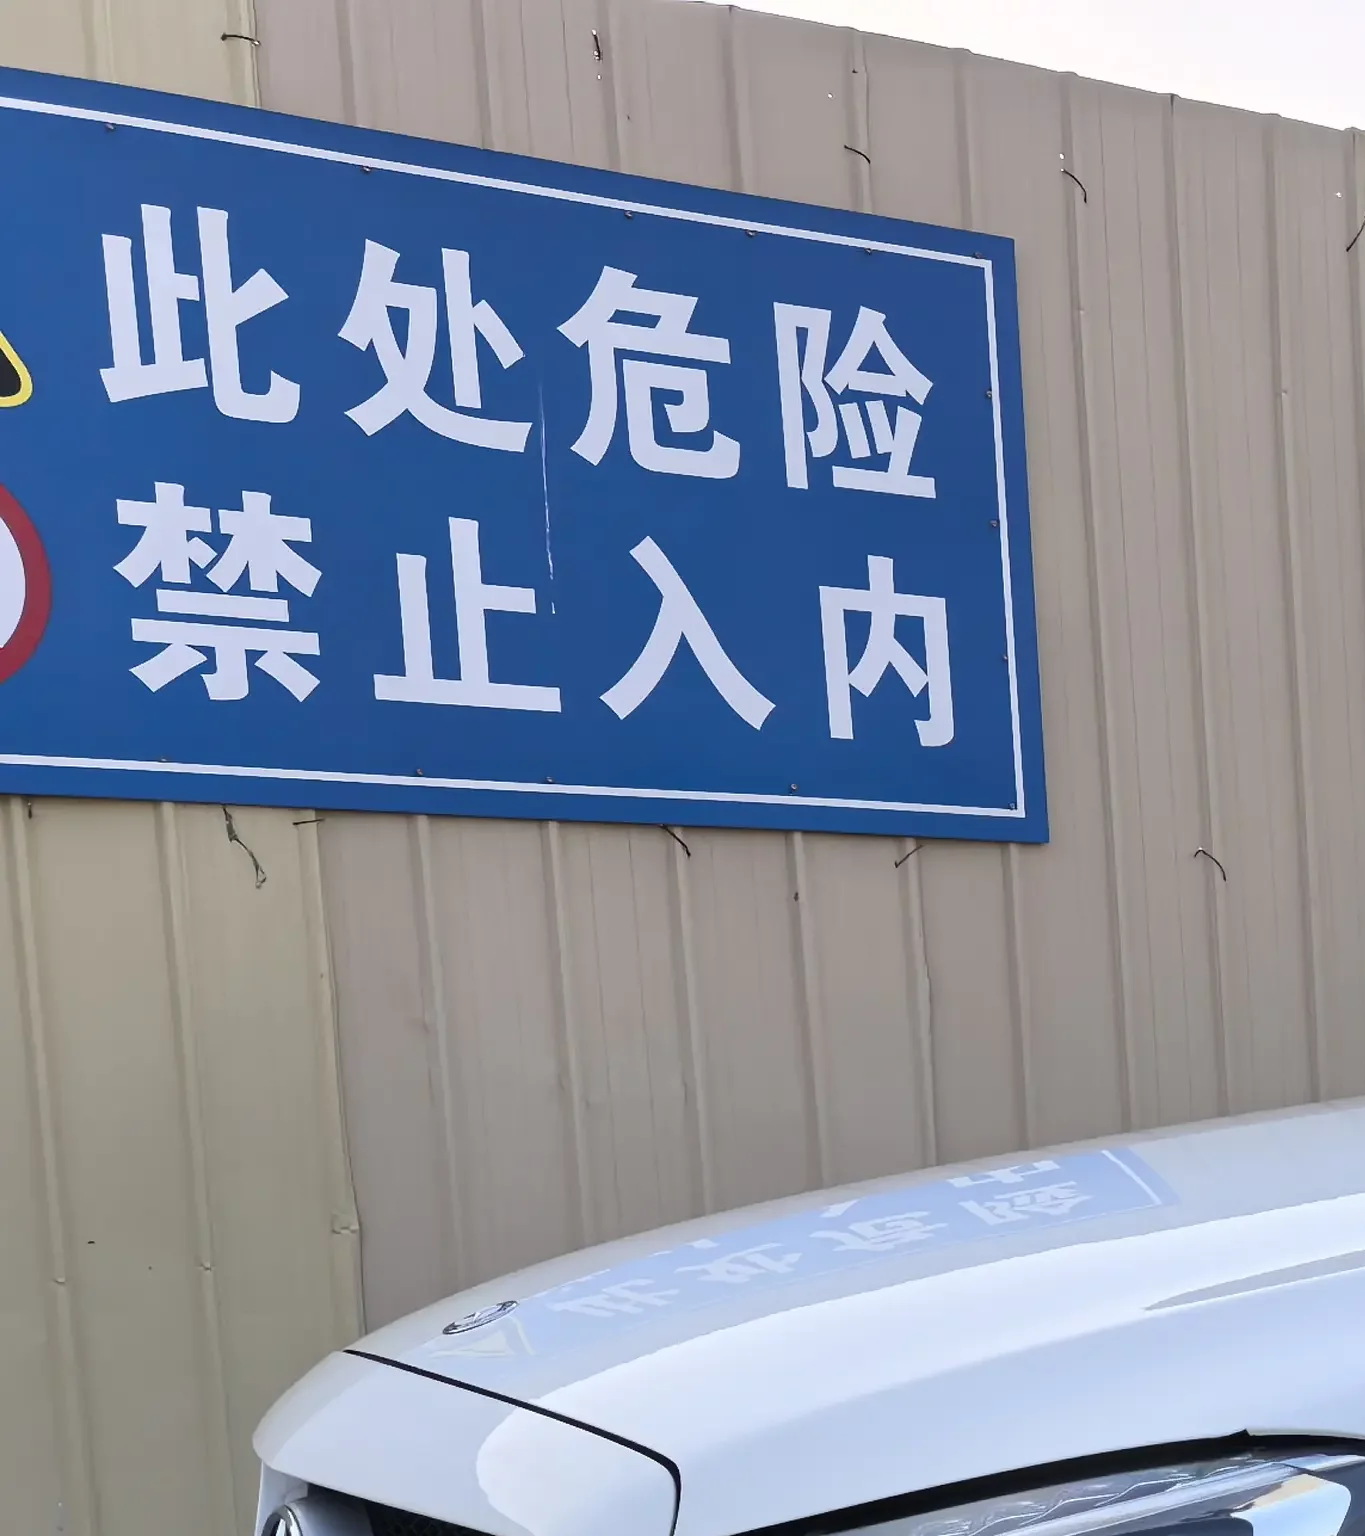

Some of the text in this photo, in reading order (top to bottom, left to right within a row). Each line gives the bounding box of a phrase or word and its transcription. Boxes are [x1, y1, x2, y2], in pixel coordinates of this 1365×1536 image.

[100, 204, 937, 498] 此处危险
[113, 482, 955, 747] 禁止入内
